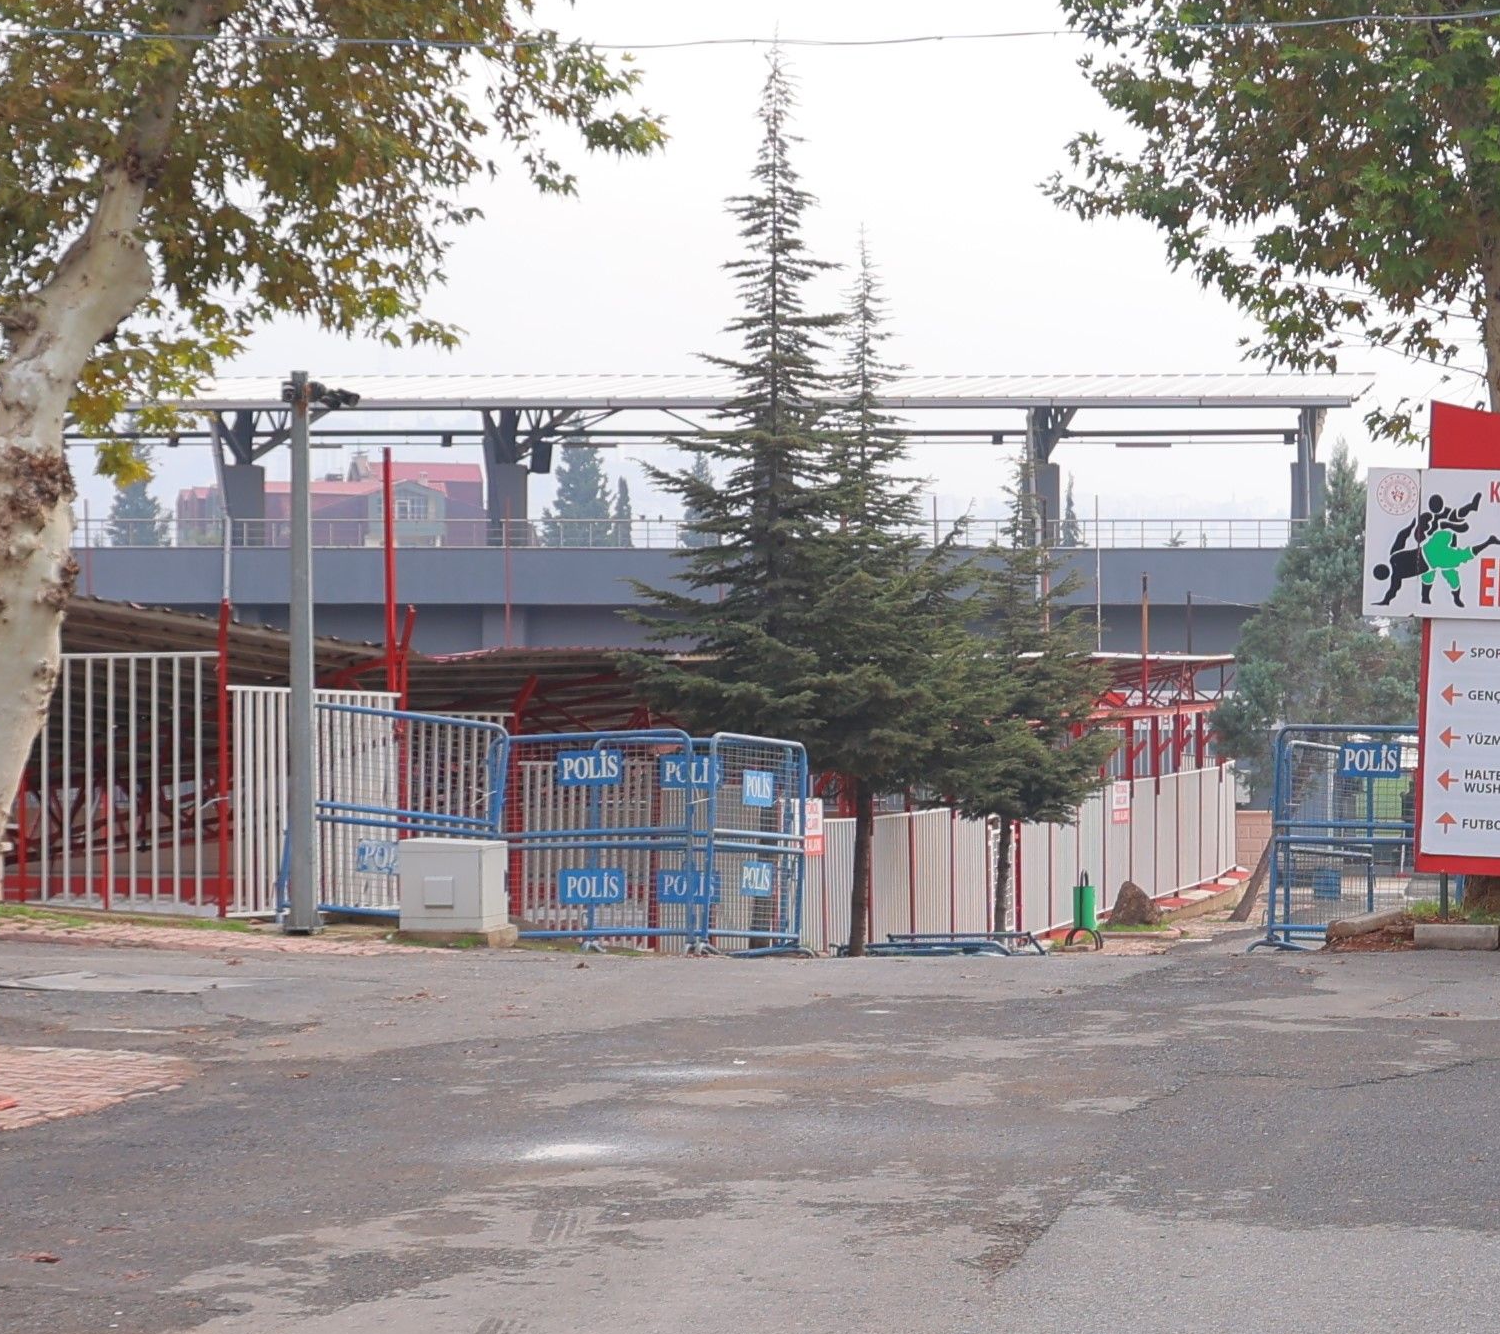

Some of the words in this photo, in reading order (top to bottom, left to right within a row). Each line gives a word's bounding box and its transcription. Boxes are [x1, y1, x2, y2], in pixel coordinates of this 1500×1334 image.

[563, 750, 619, 779] POLİS
[1343, 745, 1398, 772] POLİS
[745, 771, 771, 800] POLİS
[567, 869, 619, 898] POLİS
[743, 864, 770, 890] POLİS
